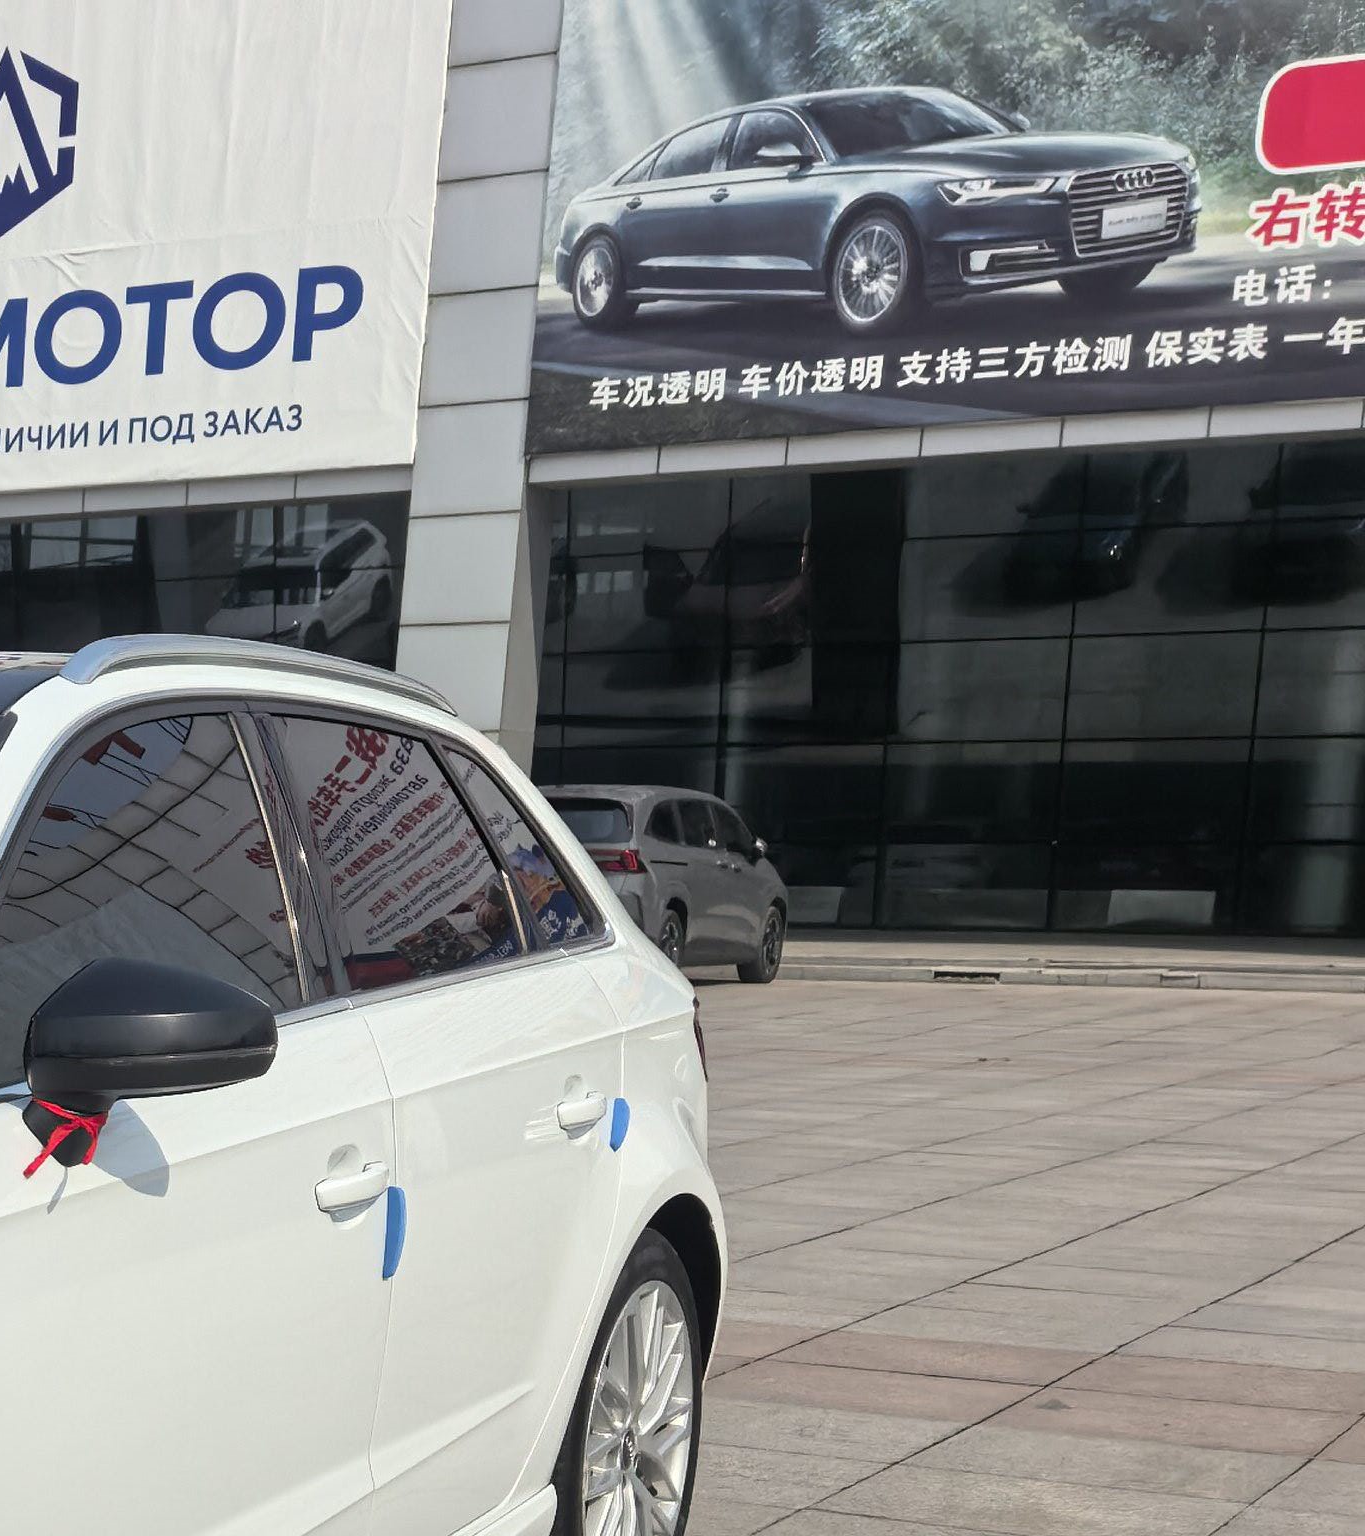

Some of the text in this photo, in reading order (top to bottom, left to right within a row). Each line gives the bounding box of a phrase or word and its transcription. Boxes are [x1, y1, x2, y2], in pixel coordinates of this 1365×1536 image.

[589, 367, 727, 411] 车况透明
[738, 355, 884, 400] 车价透明
[897, 334, 1132, 388] 支持三方检测
[1145, 322, 1269, 368] 保实表
[98, 420, 119, 445] И
[127, 413, 195, 446] ПОД
[203, 403, 303, 438] ЗАКАЗ
